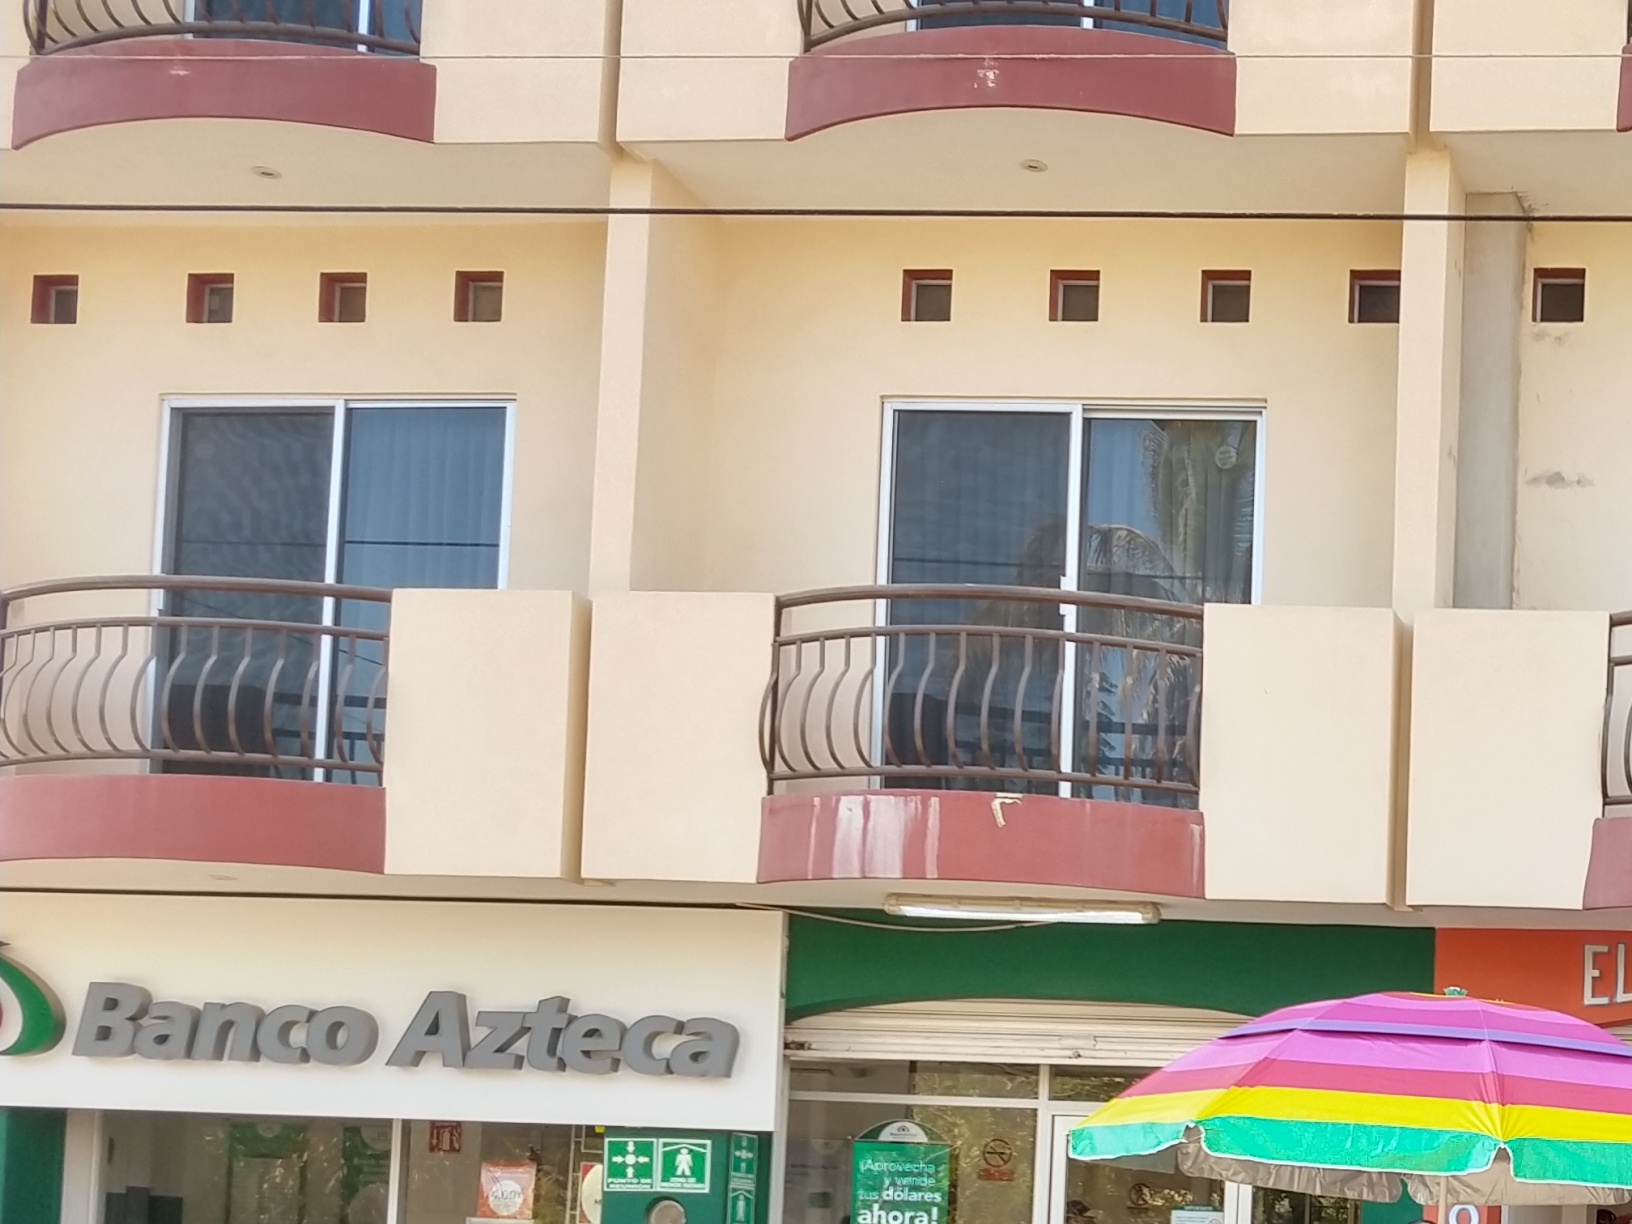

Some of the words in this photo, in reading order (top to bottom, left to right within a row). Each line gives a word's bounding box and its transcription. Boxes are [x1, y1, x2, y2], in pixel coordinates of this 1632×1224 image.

[72, 982, 379, 1066] Banco
[385, 989, 741, 1079] Azteca
[859, 1158, 935, 1174] ¡Aprovecha
[884, 1176, 890, 1188] y
[895, 1174, 935, 1187] vende
[857, 1188, 879, 1200] tus
[882, 1184, 942, 1201] dólares
